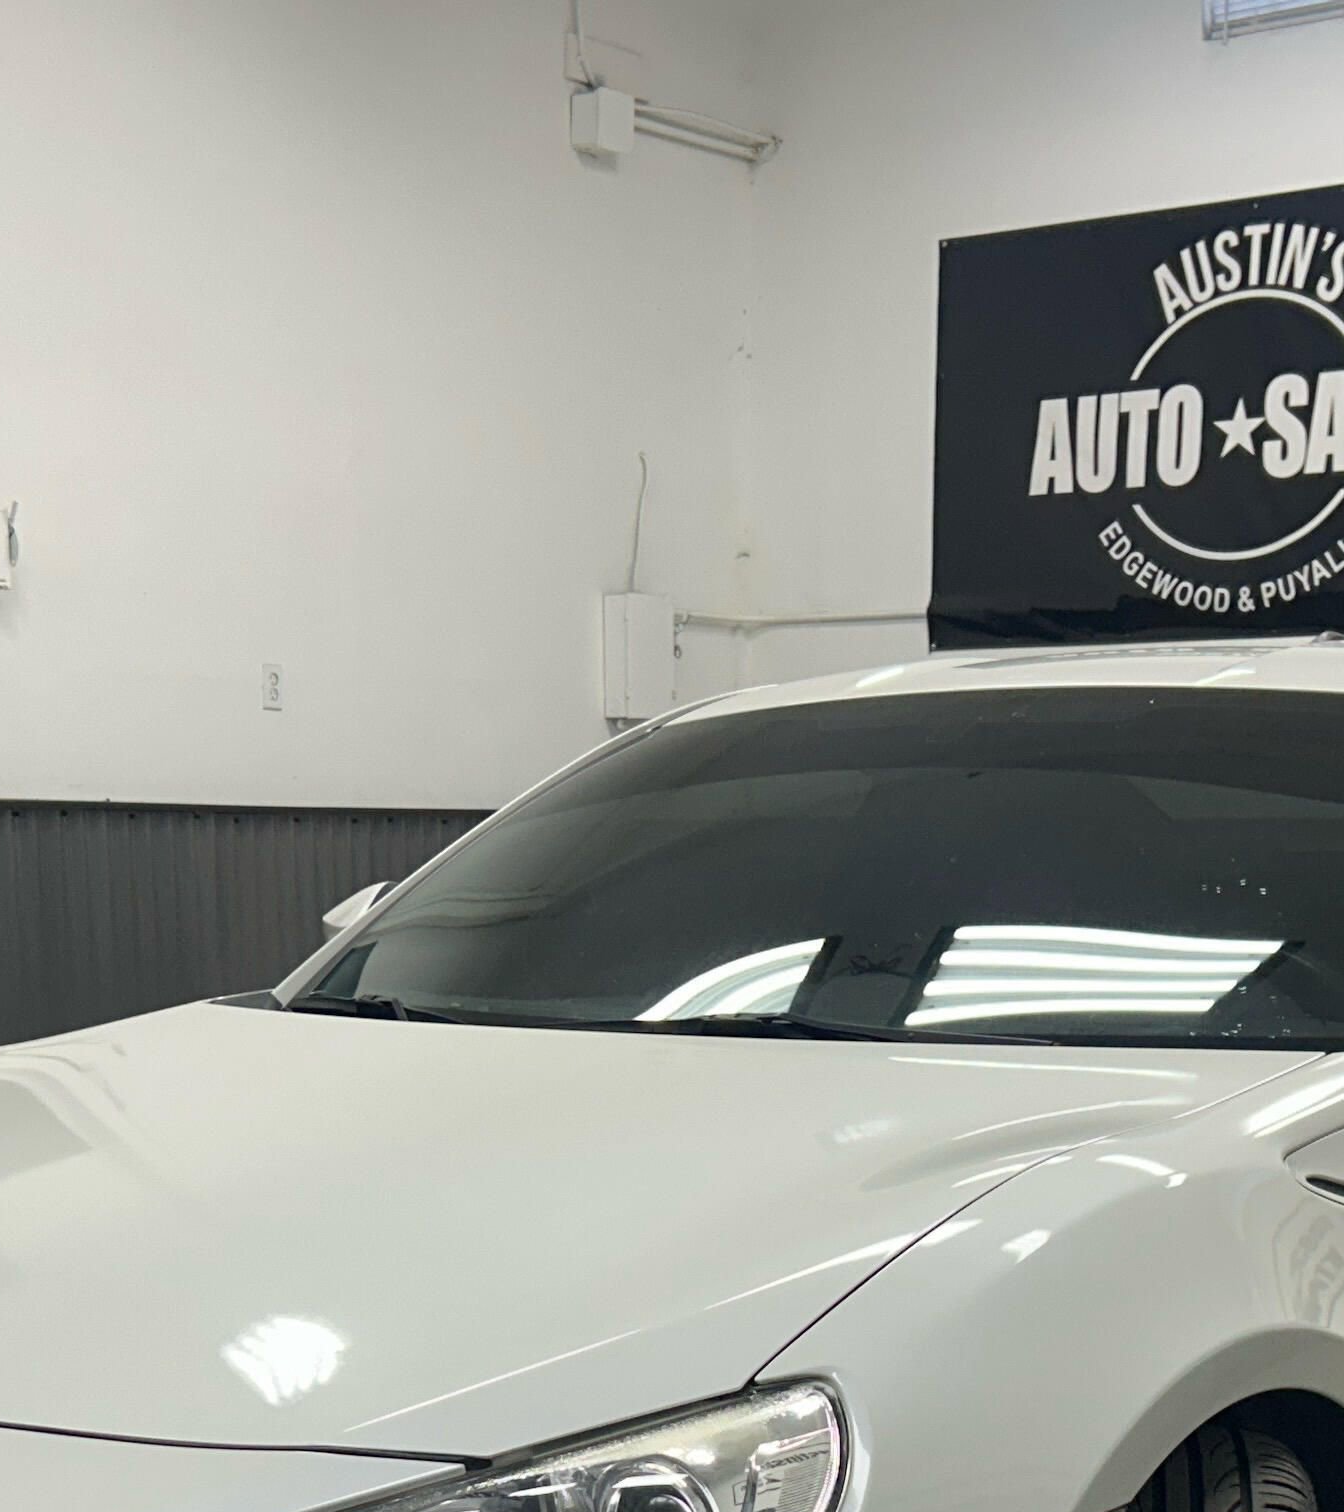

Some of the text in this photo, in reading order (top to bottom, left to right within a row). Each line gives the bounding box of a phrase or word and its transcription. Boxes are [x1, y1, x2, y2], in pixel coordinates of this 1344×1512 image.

[1028, 383, 1204, 497] AUTO
[1098, 520, 1231, 613] EDGEWOOD
[1237, 585, 1256, 613] &
